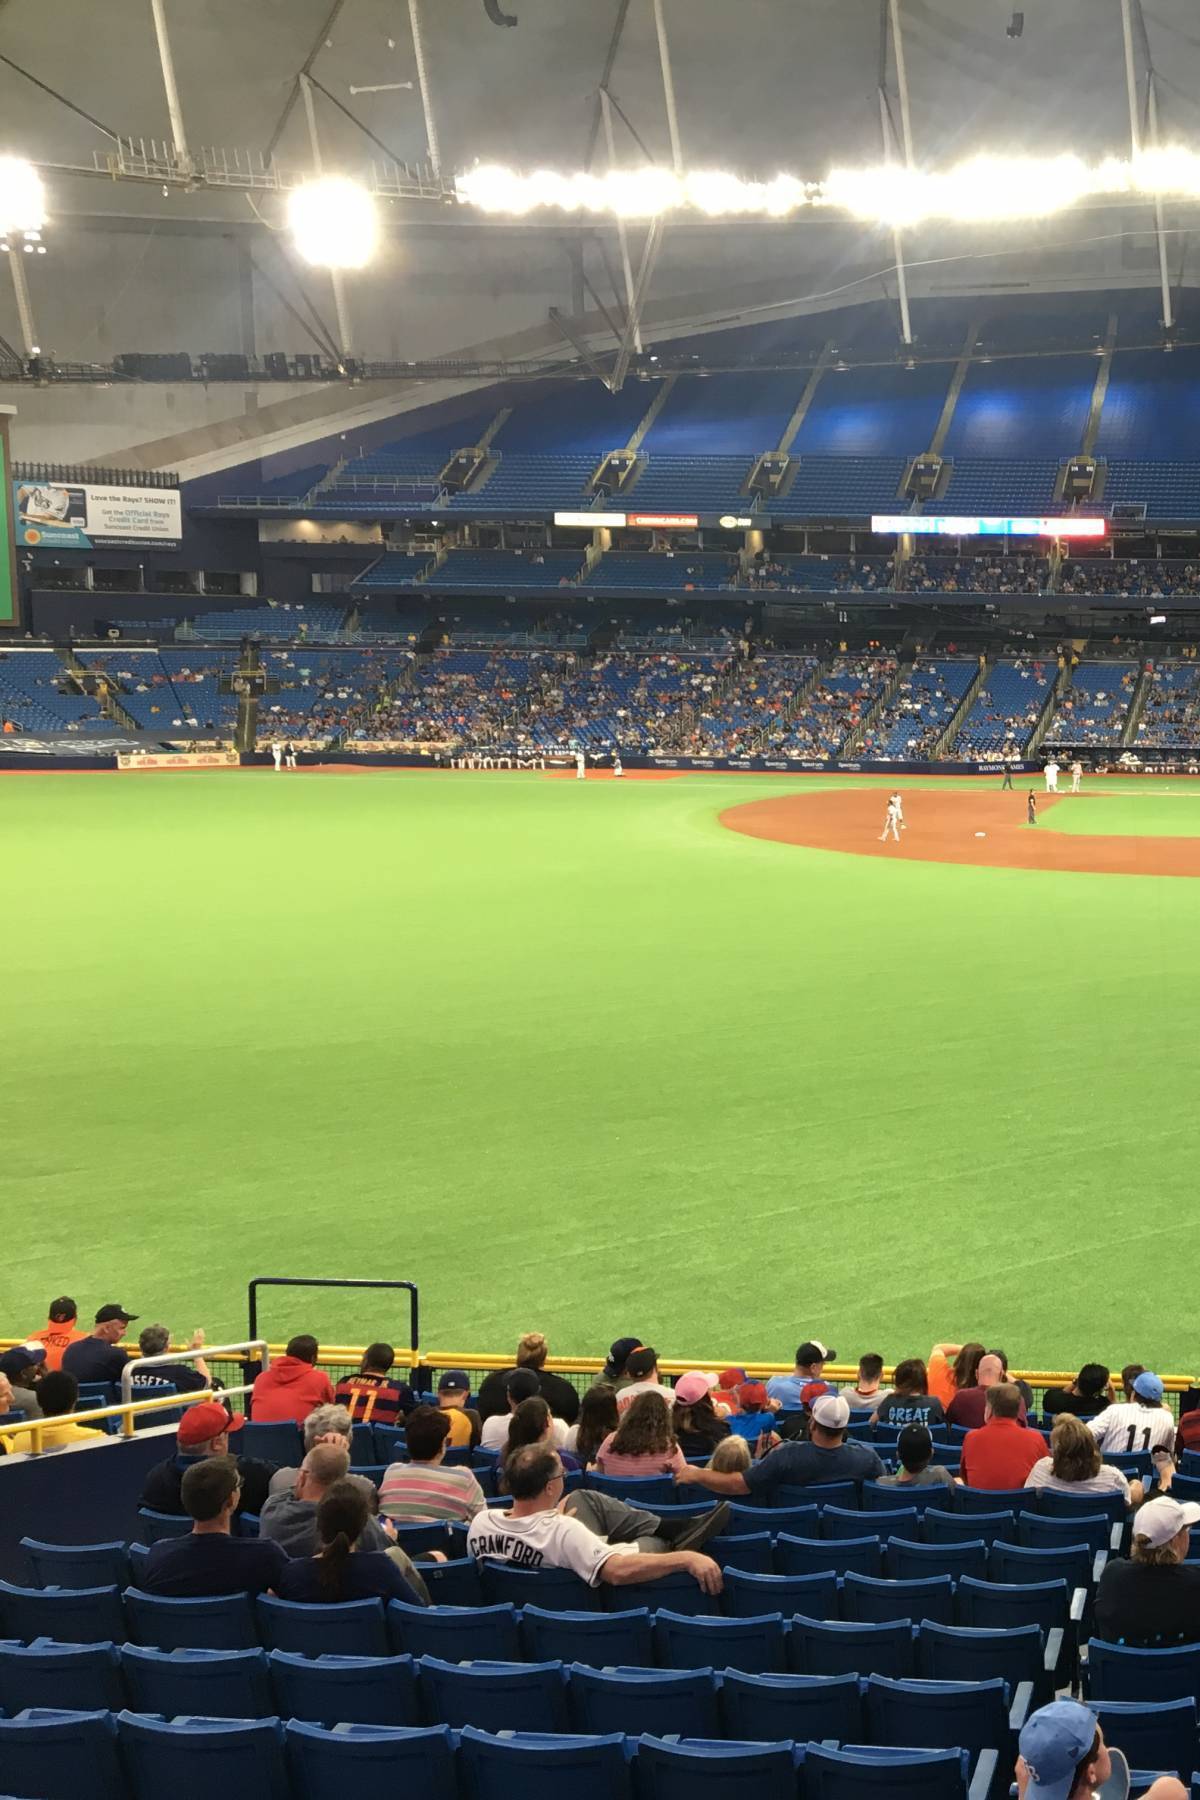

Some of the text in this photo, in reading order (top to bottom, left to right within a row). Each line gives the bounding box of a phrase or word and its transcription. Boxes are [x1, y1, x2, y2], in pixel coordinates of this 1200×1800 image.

[348, 1388, 378, 1424] 11
[888, 1406, 931, 1422] GREAT
[1127, 1424, 1152, 1452] 11
[470, 1534, 544, 1568] CRAWFORD
